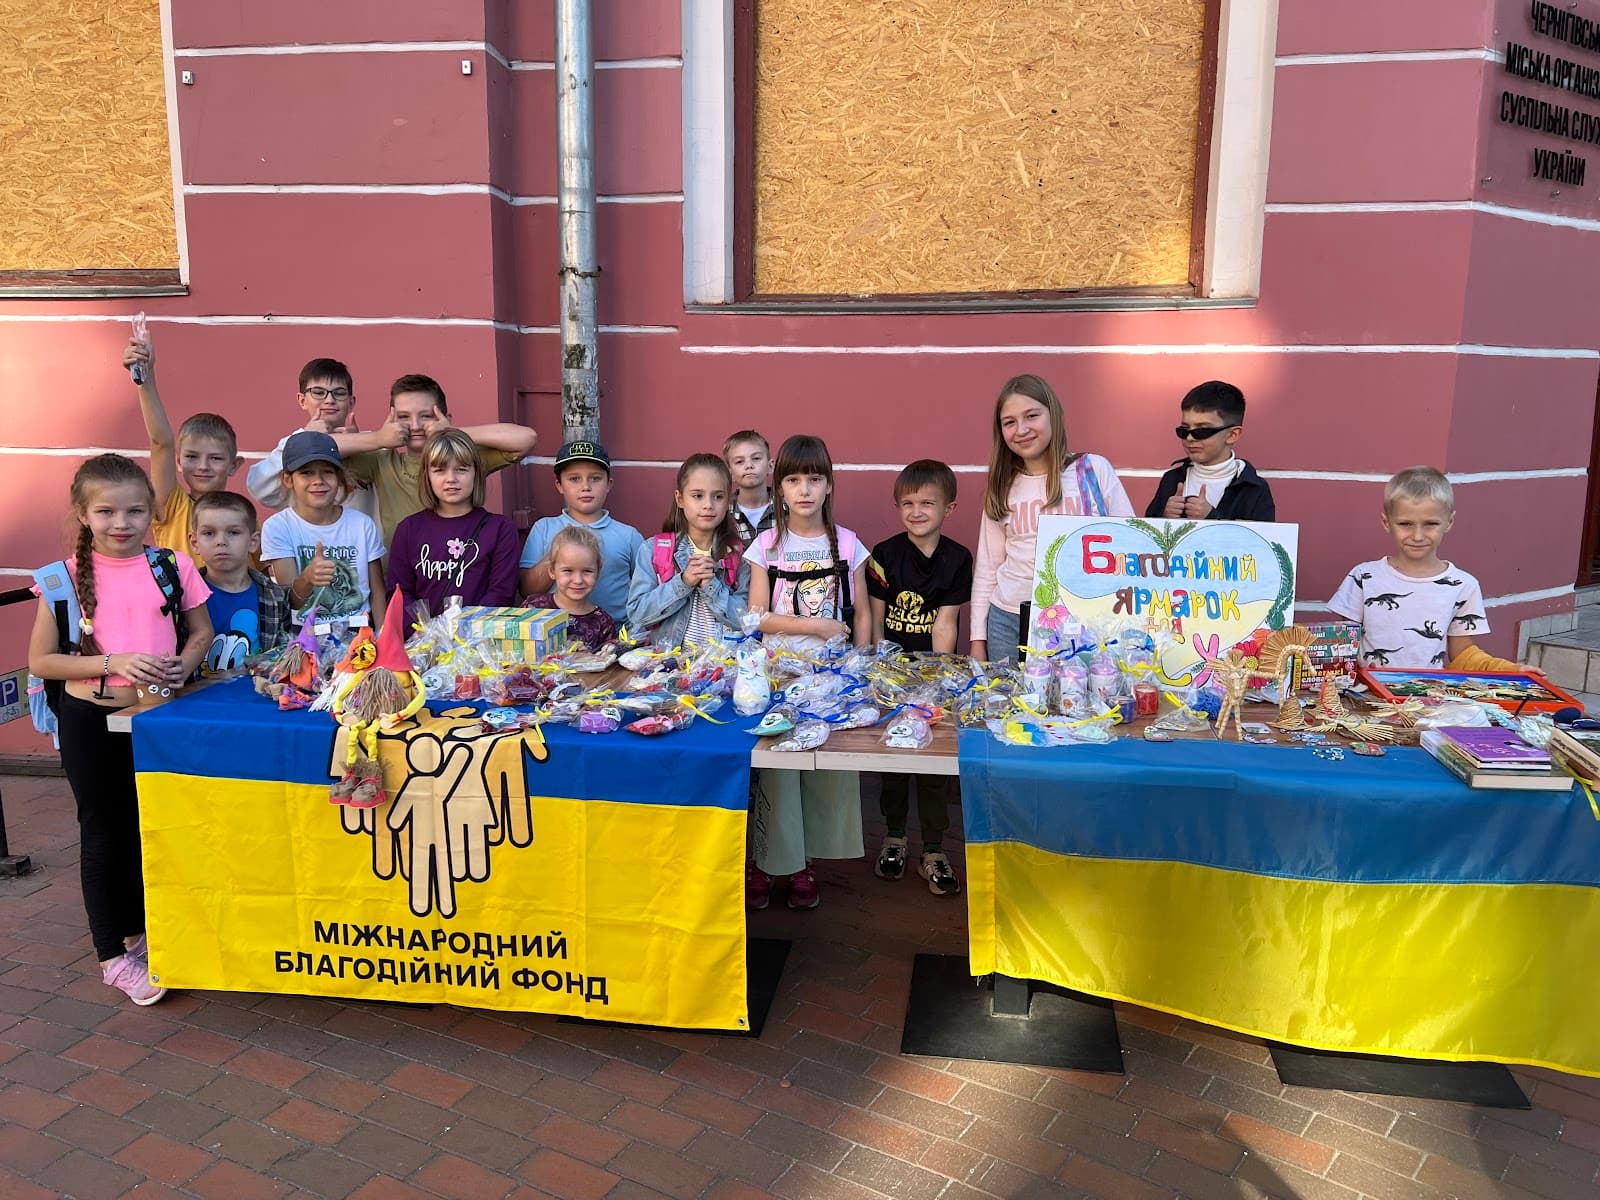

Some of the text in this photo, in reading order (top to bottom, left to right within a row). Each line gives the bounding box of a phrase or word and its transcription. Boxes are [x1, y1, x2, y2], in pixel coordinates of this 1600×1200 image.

[1505, 42, 1600, 99] МІСЬКА ОРГАНІЗ
[1501, 91, 1569, 137] СУСПІЛЬНА
[1533, 147, 1586, 186] УКРАЇНИ
[415, 543, 480, 588] happy
[785, 550, 833, 561] INDERELLA
[1081, 534, 1257, 582] Благодійний
[2, 680, 16, 706] P
[314, 920, 568, 960] МІЖНАРОДНИЙ
[274, 951, 609, 1005] БЛАГОДІЙНИЙ ФОНД
